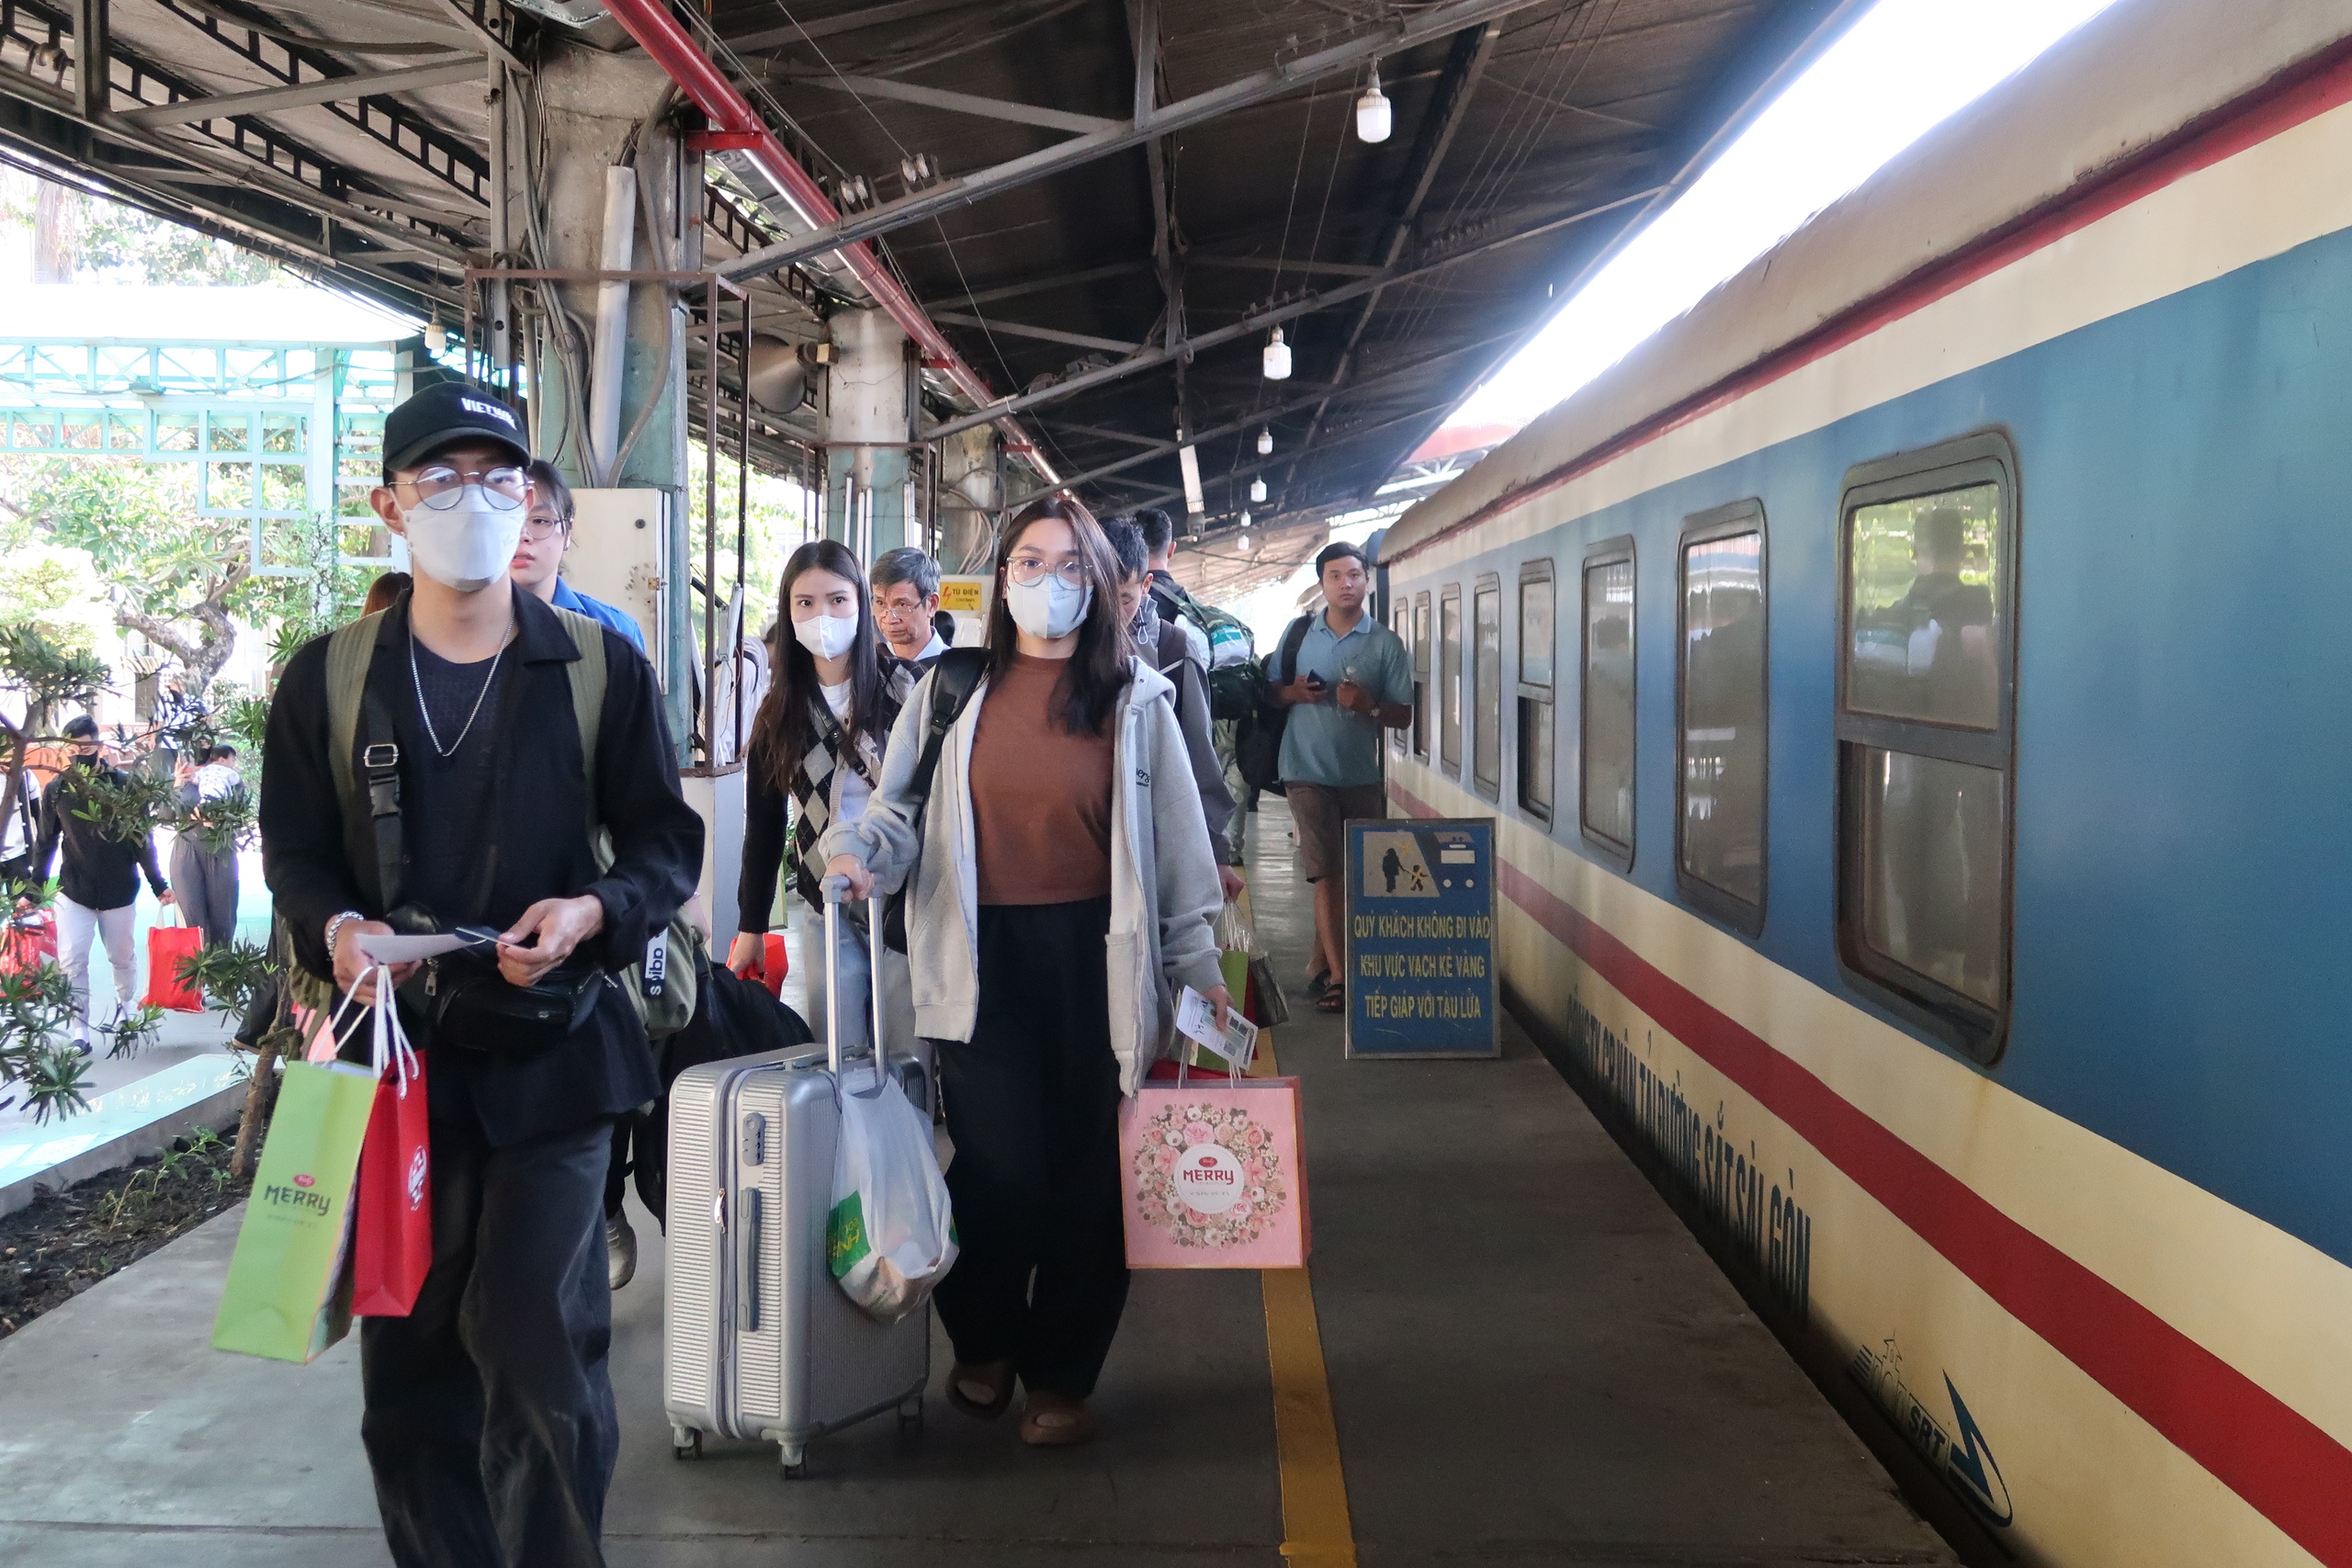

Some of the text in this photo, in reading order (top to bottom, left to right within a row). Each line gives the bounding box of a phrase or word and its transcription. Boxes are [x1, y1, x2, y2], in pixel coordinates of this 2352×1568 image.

[1378, 909, 1415, 938] KHÁCH
[1417, 909, 1453, 939] KHÔNG
[1456, 916, 1467, 939] ĐI
[1468, 909, 1491, 939] VÀO
[1360, 954, 1382, 977] KHU
[1408, 954, 1437, 982] VẠCH
[1455, 949, 1486, 978] VÀNG
[1363, 986, 1387, 1018] TIẾP
[1390, 989, 1415, 1019] GIÁP
[1417, 989, 1435, 1019] VỚI
[1436, 989, 1458, 1019] TÀU
[1182, 1168, 1235, 1186] MERRY
[264, 1184, 332, 1217] MERRY
